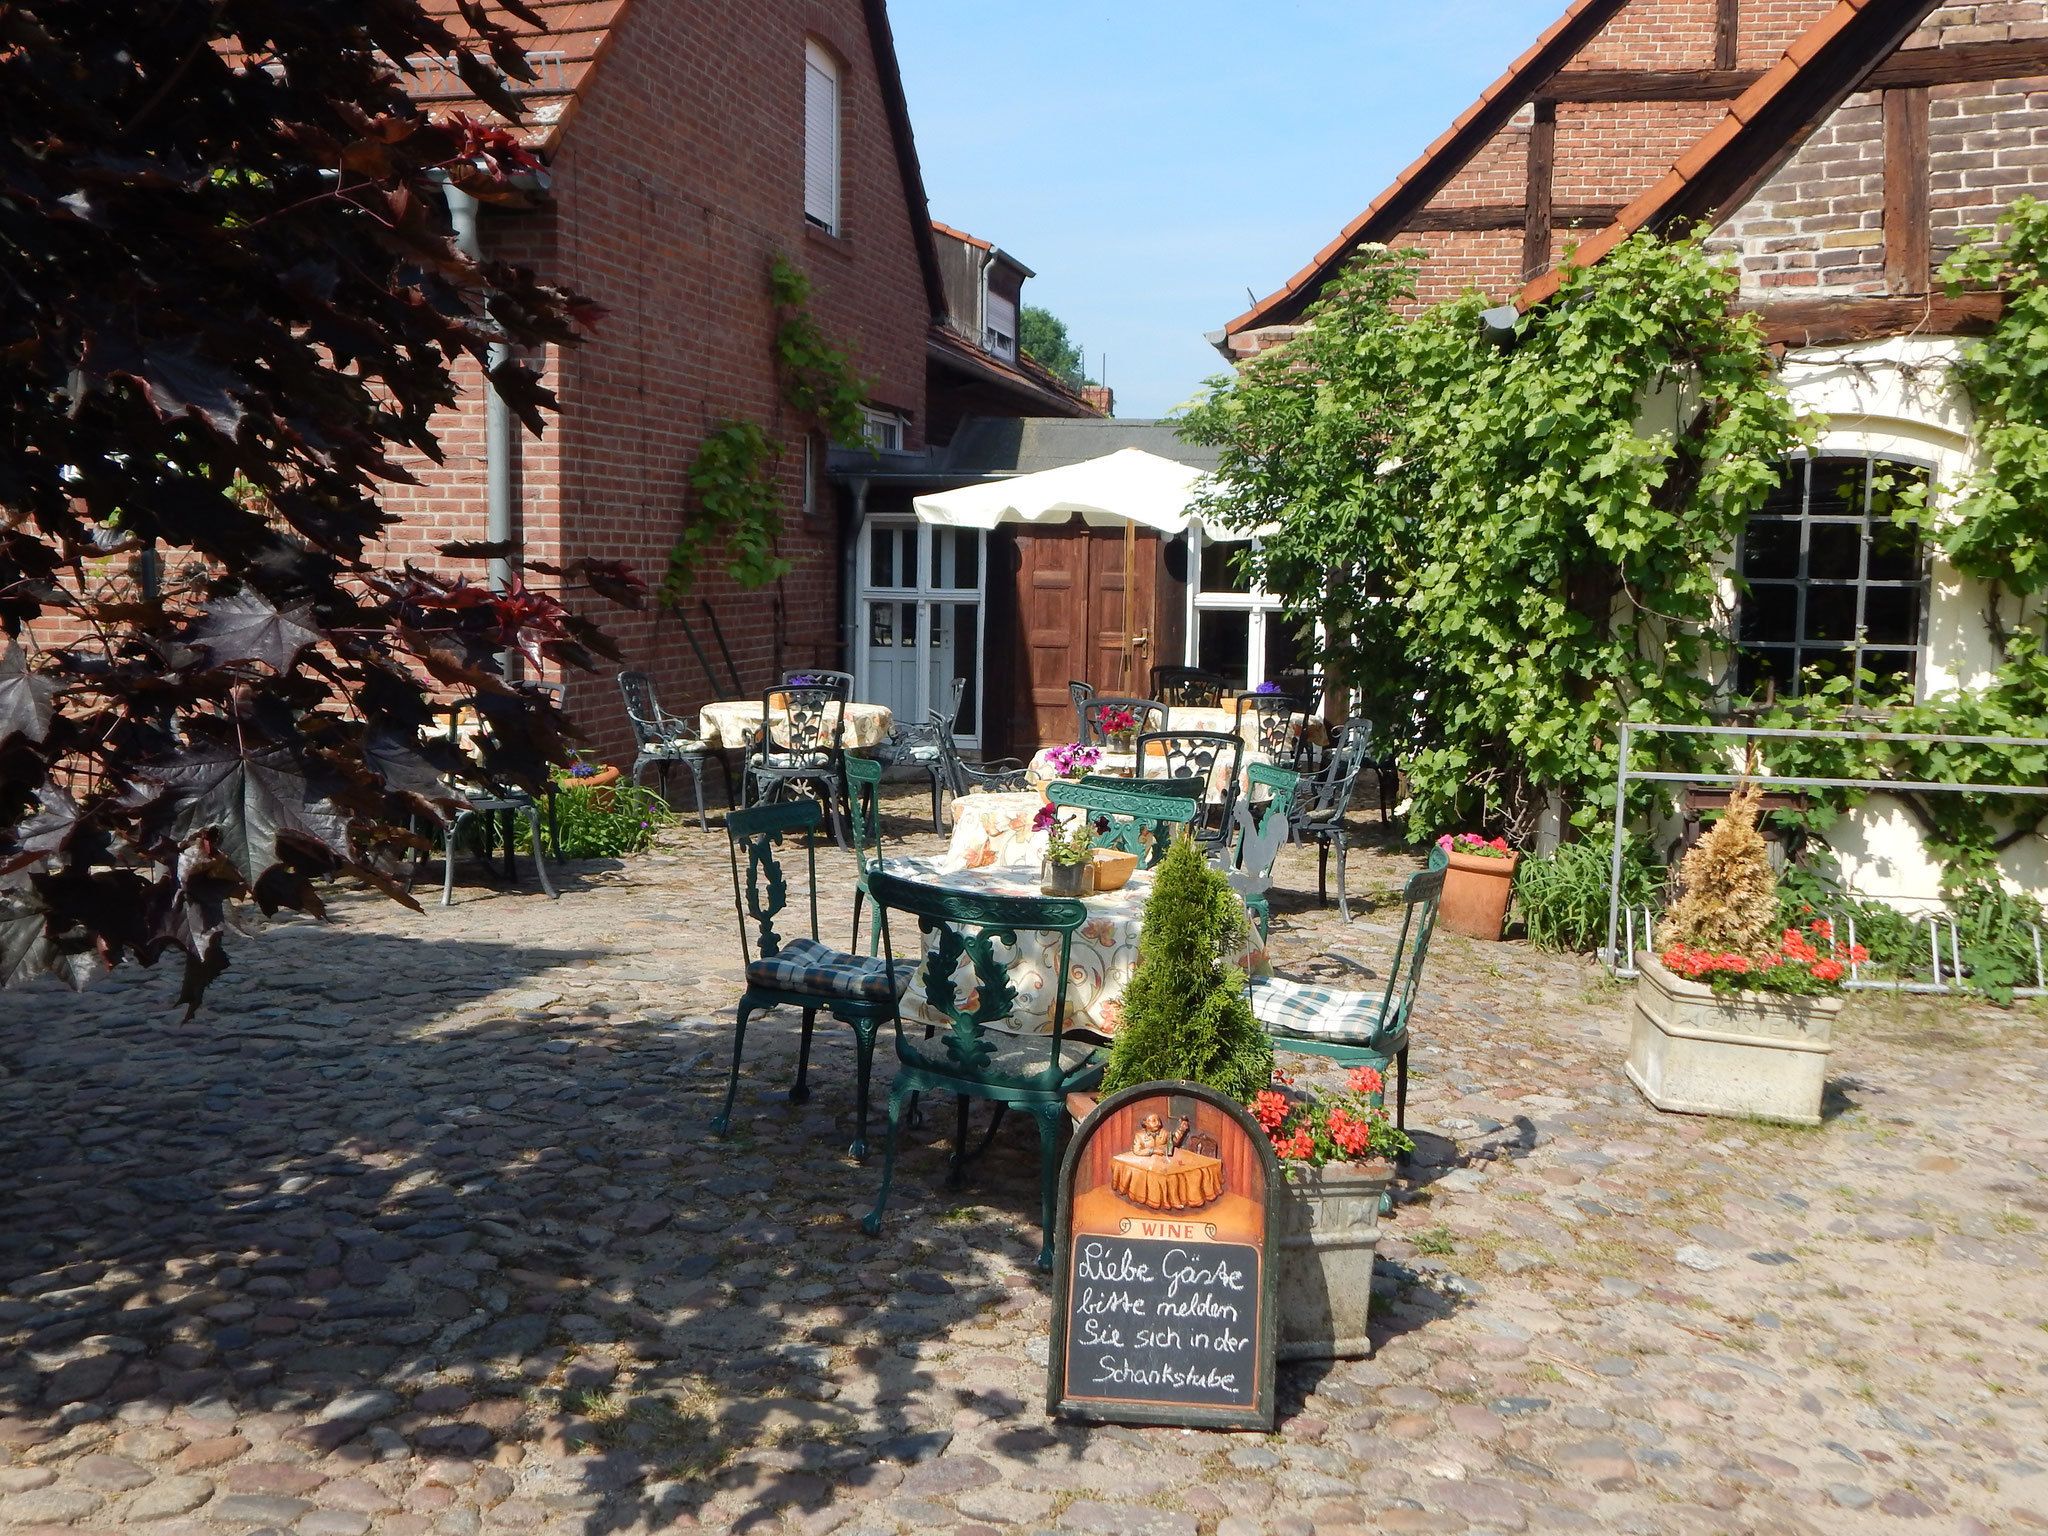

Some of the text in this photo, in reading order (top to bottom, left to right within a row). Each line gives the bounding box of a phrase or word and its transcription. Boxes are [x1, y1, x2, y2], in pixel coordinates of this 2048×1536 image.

[1142, 1222, 1194, 1239] WINE
[1079, 1243, 1244, 1299] Liebe Gäste
[1076, 1286, 1238, 1322] bitte melden
[1078, 1318, 1250, 1353] Sie sich in der
[1092, 1355, 1240, 1394] Schankstube
